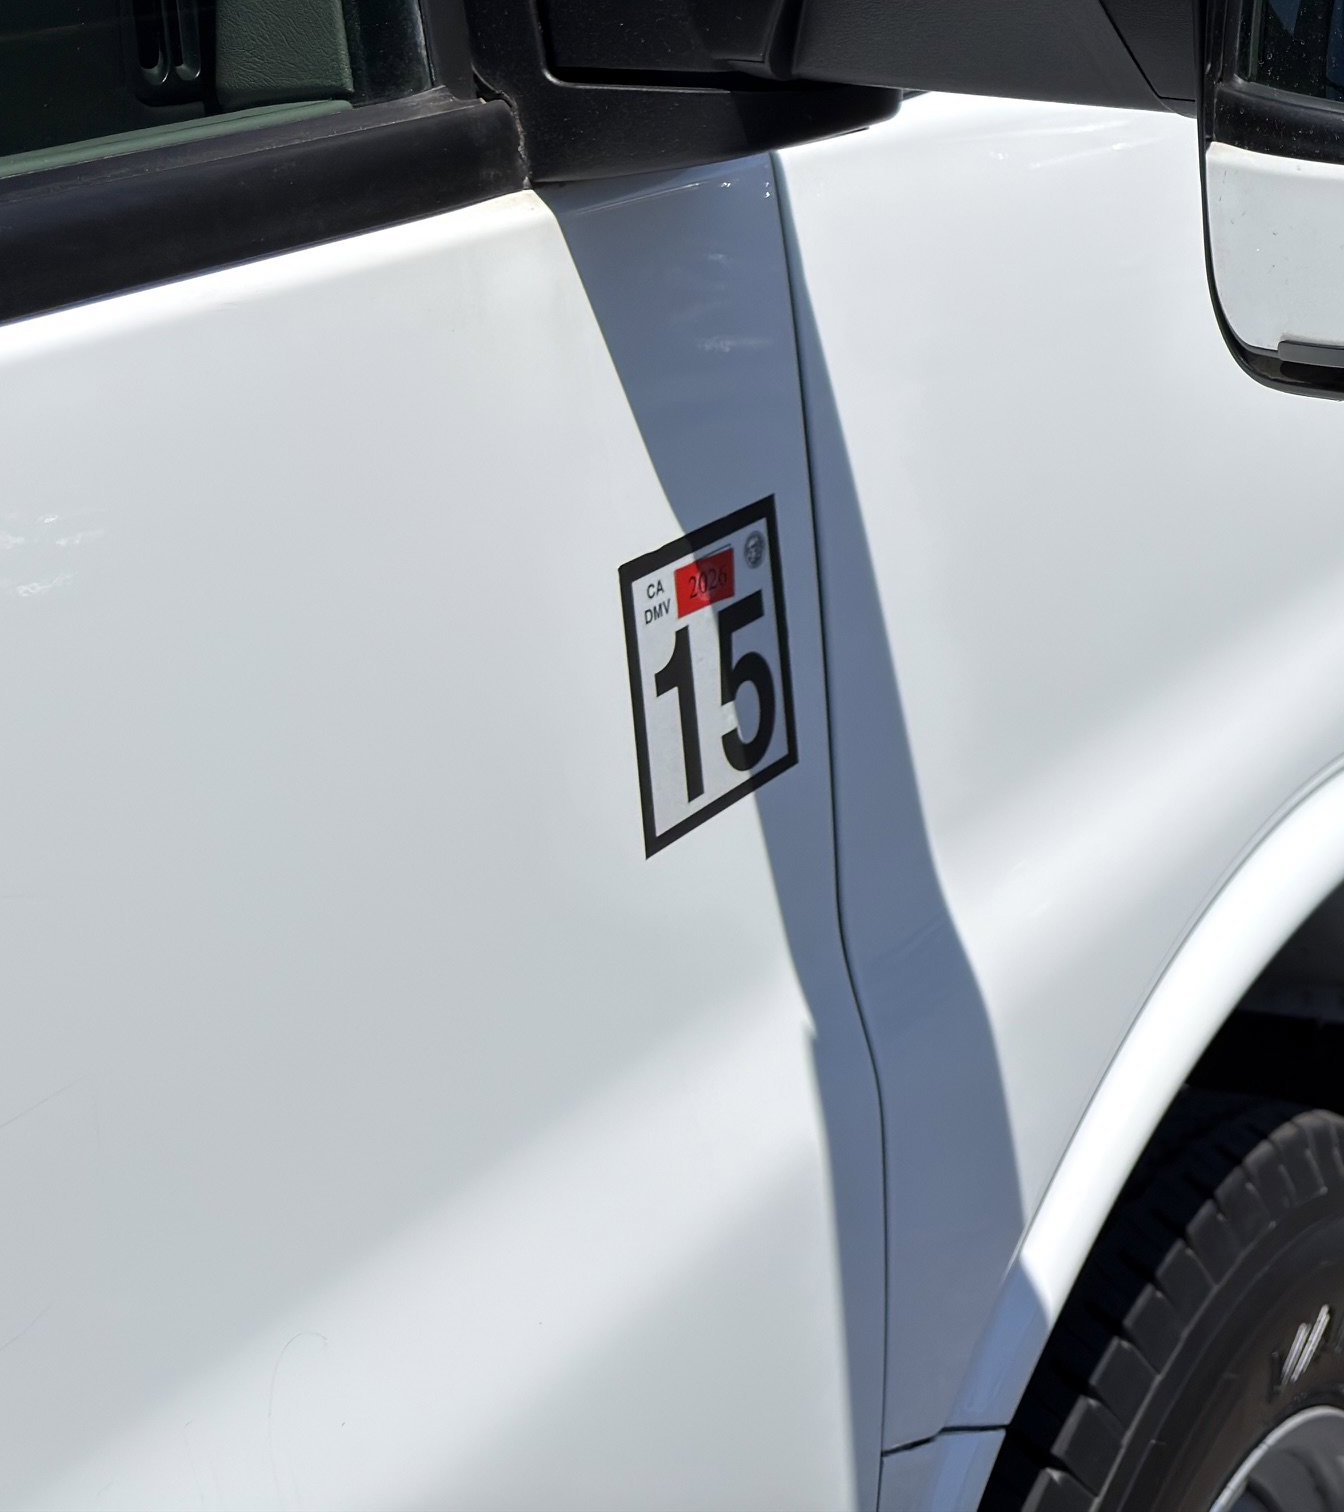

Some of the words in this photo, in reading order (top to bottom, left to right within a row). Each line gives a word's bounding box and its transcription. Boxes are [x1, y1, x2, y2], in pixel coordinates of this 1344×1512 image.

[646, 579, 664, 599] CA
[688, 567, 727, 600] 2026
[644, 598, 671, 625] DMV
[655, 589, 776, 804] 15
